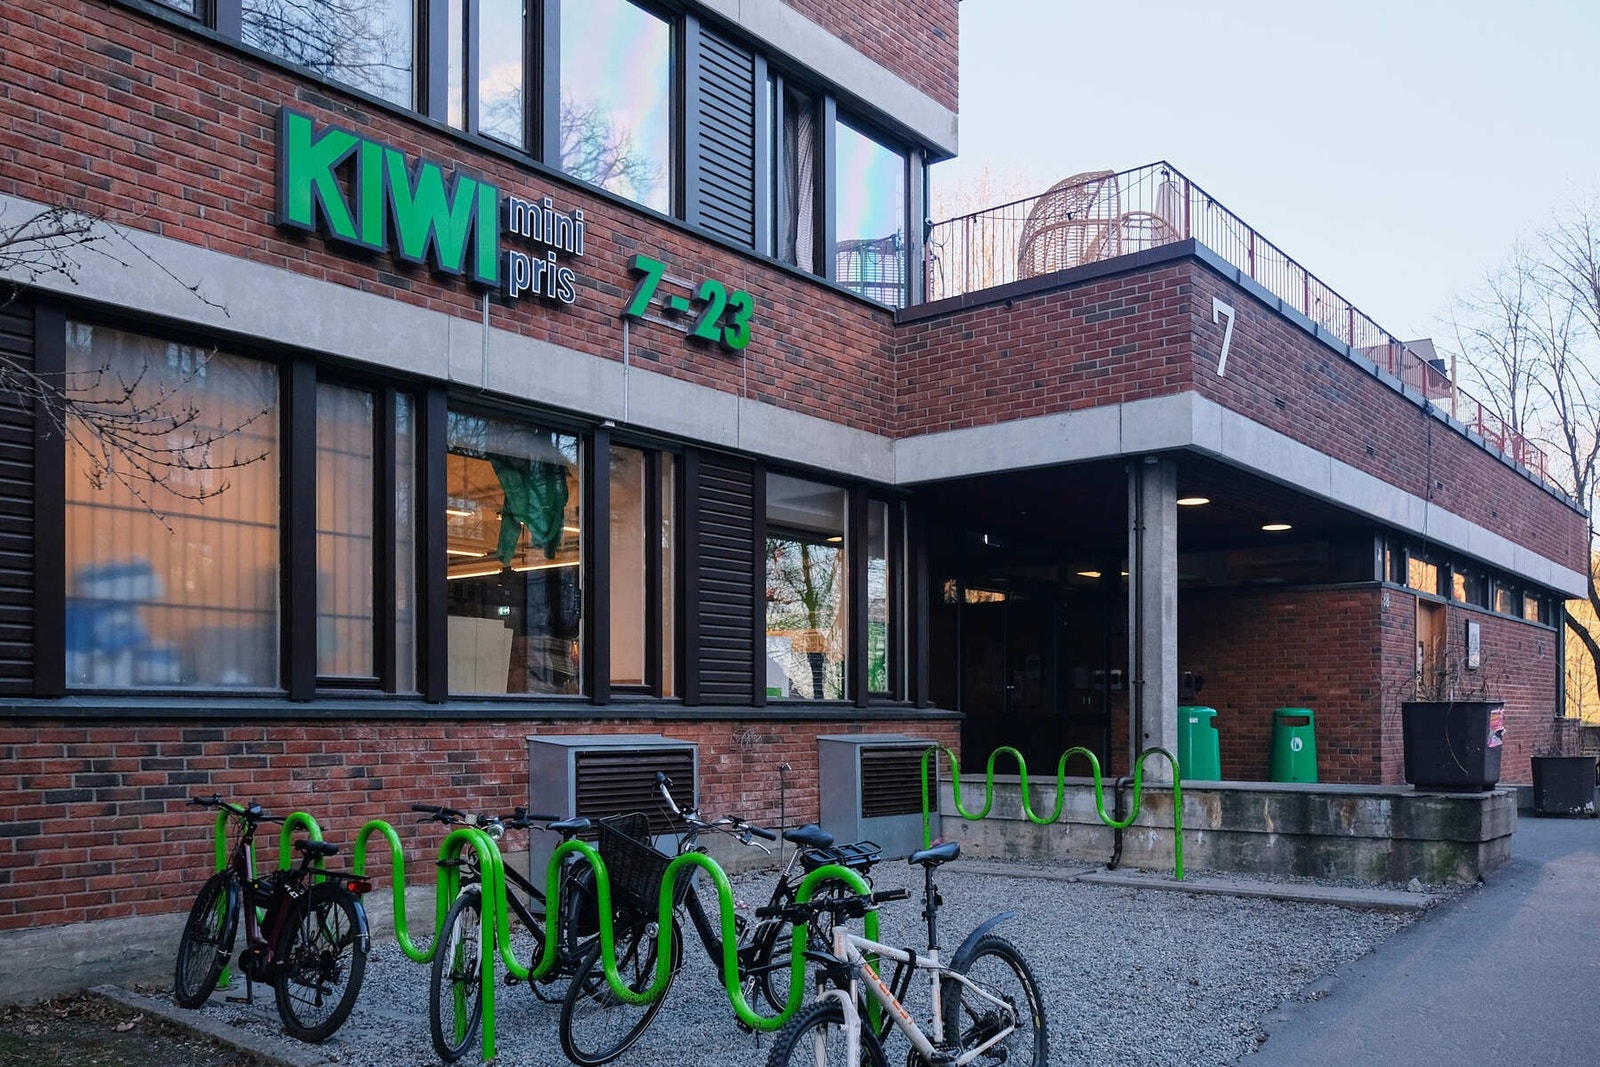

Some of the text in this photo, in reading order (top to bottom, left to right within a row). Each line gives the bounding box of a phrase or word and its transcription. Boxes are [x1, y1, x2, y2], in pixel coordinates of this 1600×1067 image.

[277, 106, 500, 287] KIWI
[509, 196, 584, 257] mini
[509, 250, 576, 304] pris
[1212, 296, 1235, 377] 7
